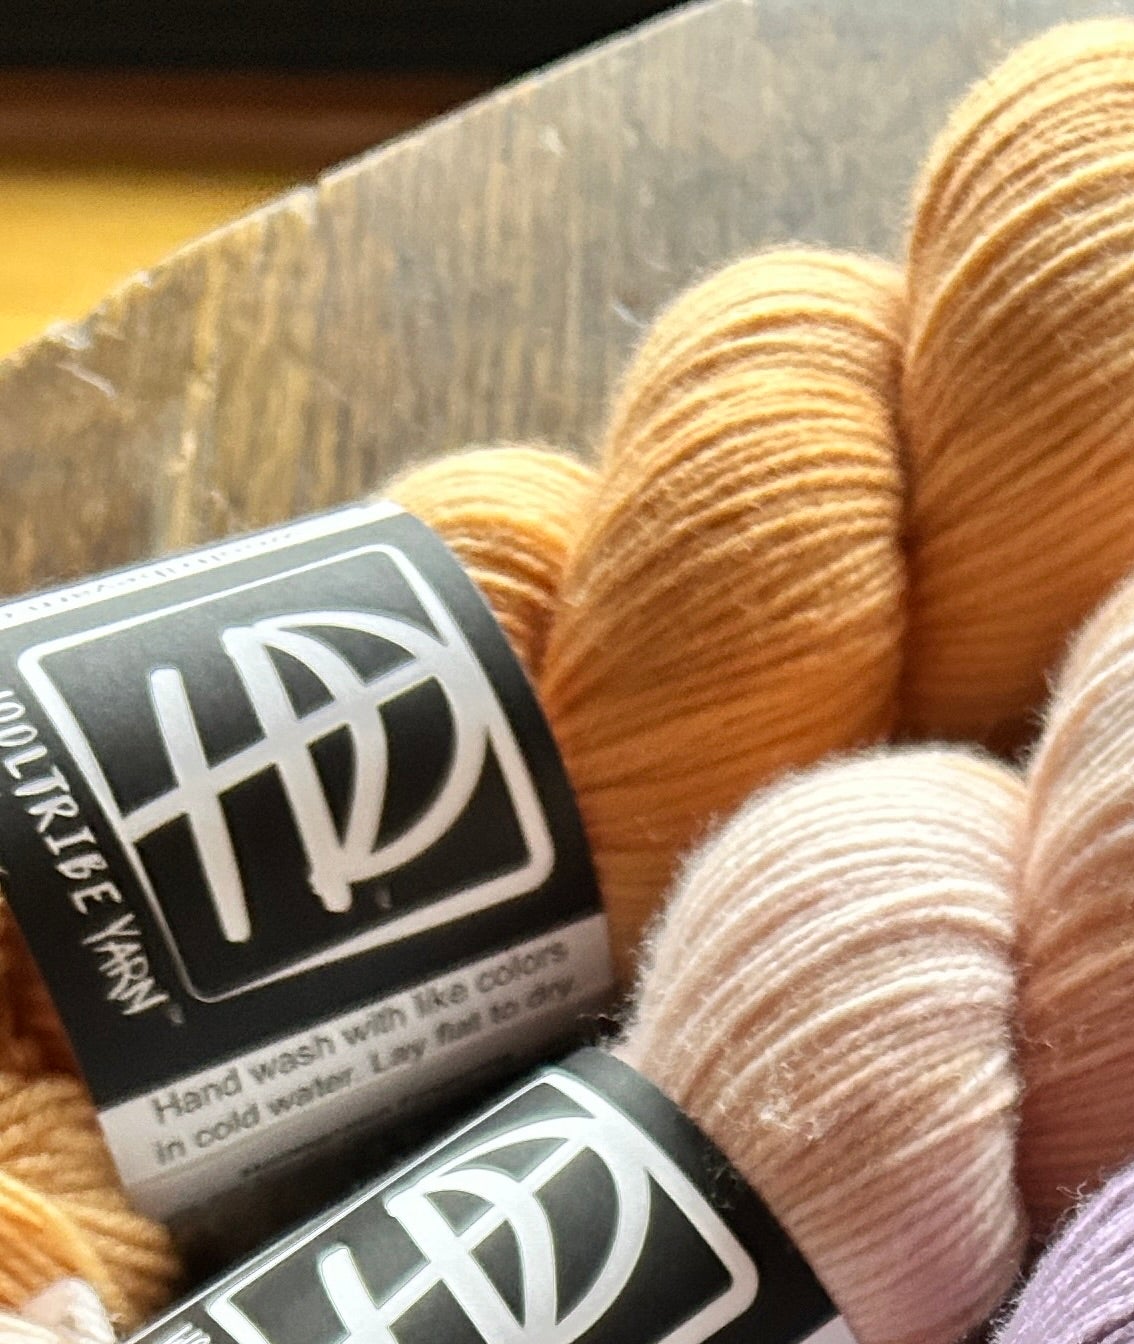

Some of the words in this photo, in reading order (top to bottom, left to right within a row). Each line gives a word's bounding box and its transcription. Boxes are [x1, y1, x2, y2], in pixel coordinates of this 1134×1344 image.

[0, 686, 122, 914] OOLTRIBE
[82, 913, 170, 1016] YARN
[150, 1066, 243, 1125] Hand
[247, 1034, 336, 1085] wash
[339, 1006, 408, 1047] with
[410, 981, 469, 1019] like
[473, 941, 569, 995] colors
